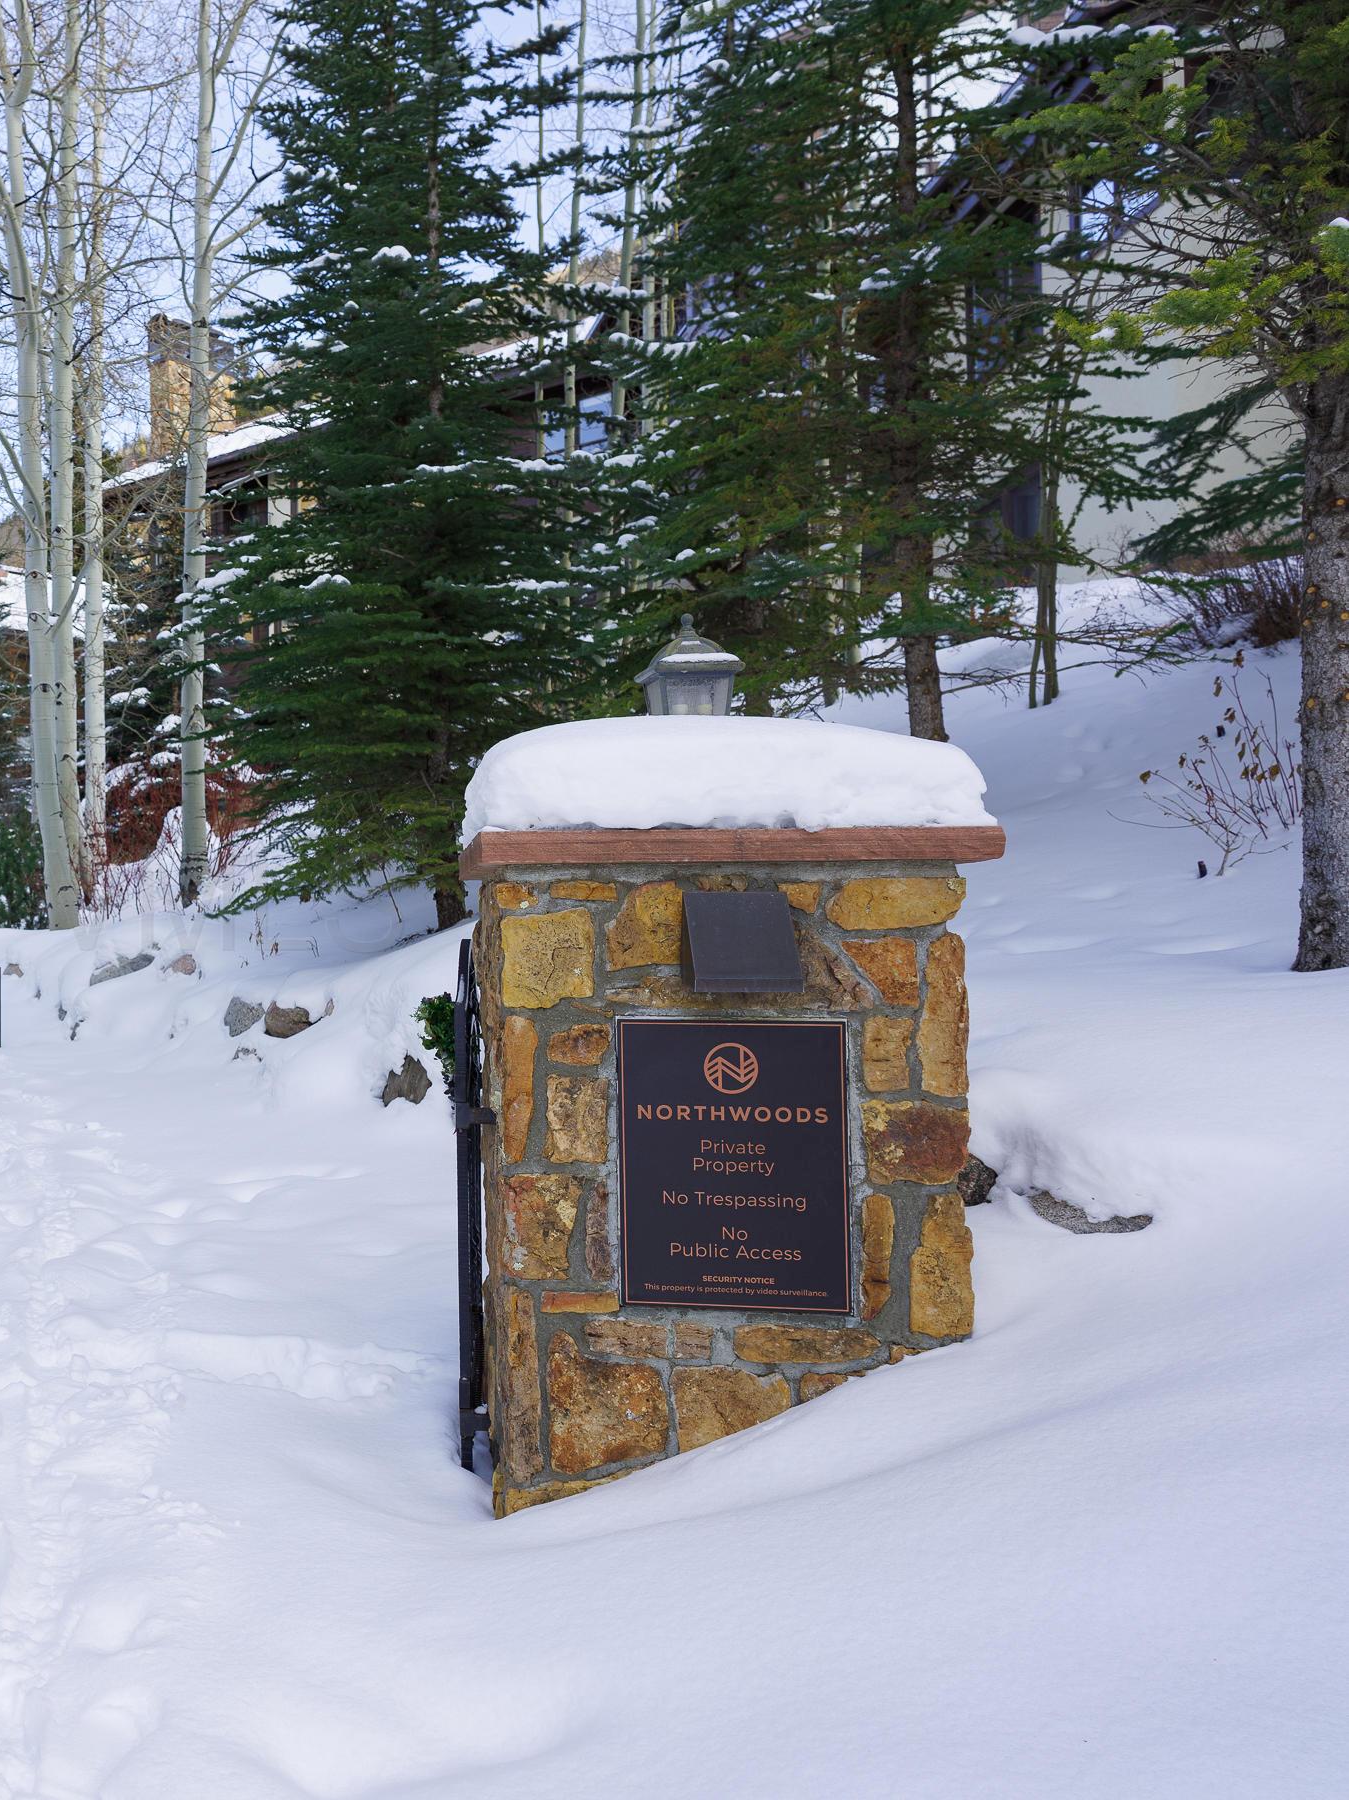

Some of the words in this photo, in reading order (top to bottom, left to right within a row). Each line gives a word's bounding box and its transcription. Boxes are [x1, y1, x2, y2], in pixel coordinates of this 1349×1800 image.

[636, 1103, 829, 1124] NORTHWOODS
[700, 1139, 766, 1156] Private
[693, 1157, 775, 1177] Property
[662, 1190, 688, 1206] No
[695, 1191, 807, 1212] Trespassing
[721, 1226, 748, 1241] No
[670, 1242, 729, 1258] Public
[735, 1245, 802, 1261] Access
[644, 1283, 660, 1291] This
[661, 1285, 695, 1293] property
[696, 1284, 703, 1292] is
[704, 1286, 743, 1294] protected
[745, 1287, 755, 1295] by
[756, 1287, 778, 1295] video
[702, 1275, 742, 1283] SECURITY
[744, 1276, 775, 1285] NOTICE
